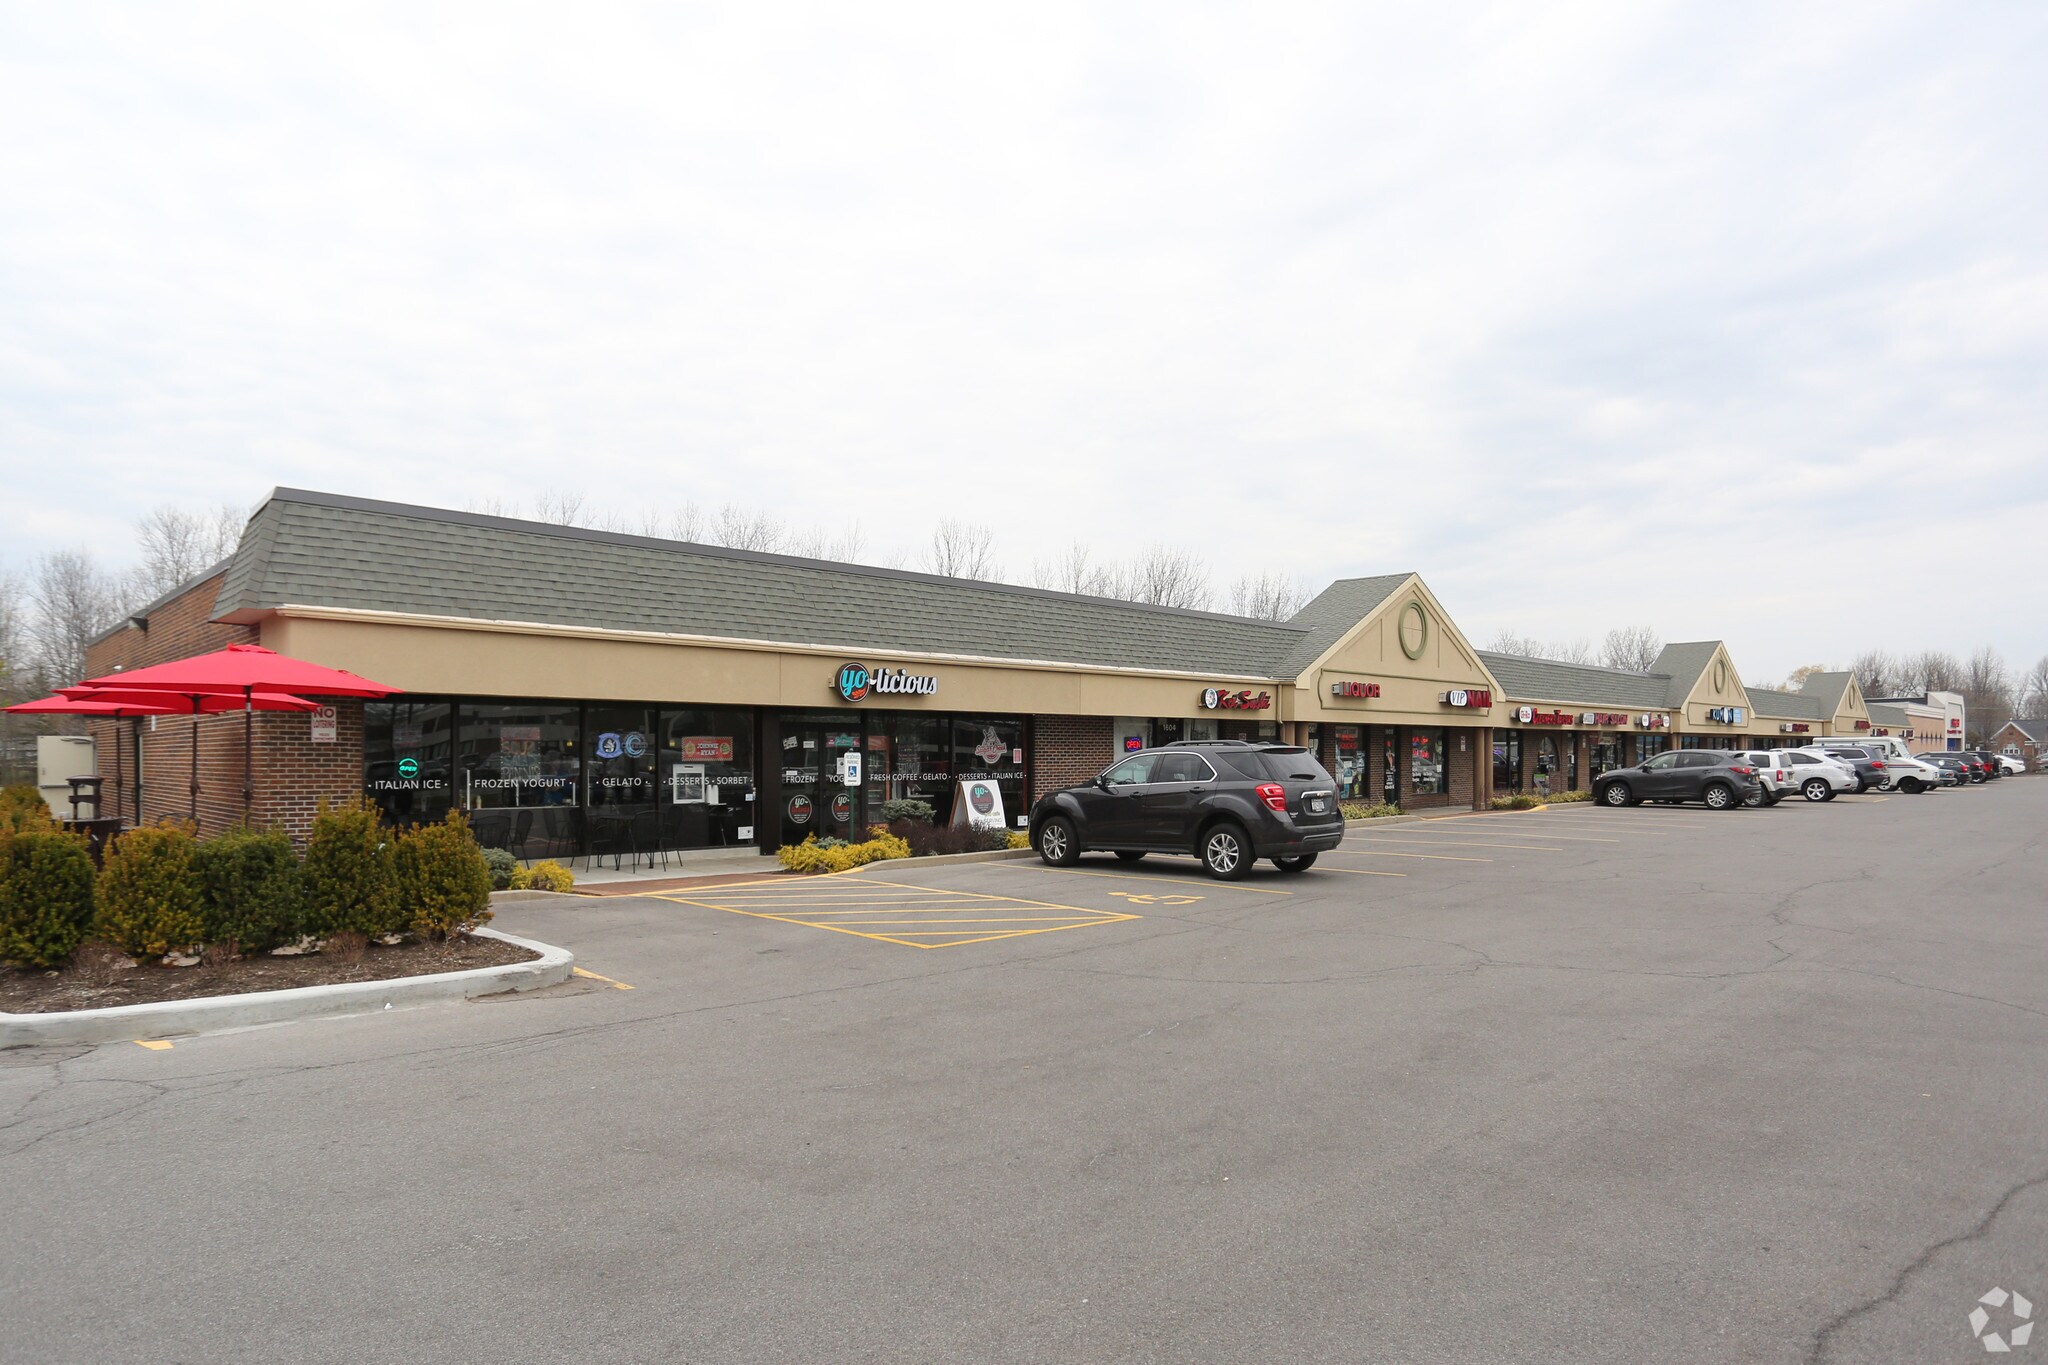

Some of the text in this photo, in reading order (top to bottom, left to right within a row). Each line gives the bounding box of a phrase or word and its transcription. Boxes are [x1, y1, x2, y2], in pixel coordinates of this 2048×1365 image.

[1342, 681, 1381, 698] LIQUOR
[1451, 691, 1466, 706] VIP
[313, 708, 335, 719] NO
[1594, 712, 1609, 725] HAIR
[1610, 713, 1628, 725] SALON
[1126, 740, 1141, 749] OPEN
[785, 775, 816, 783] FROZEN
[870, 773, 891, 781] FRESH
[1014, 771, 1024, 779] ICE
[375, 779, 441, 790] ITALIAN ICE
[474, 778, 566, 788] FROZEN YOGURT
[602, 777, 642, 787] GELATO
[668, 776, 748, 786] DESSERTS SORBET
